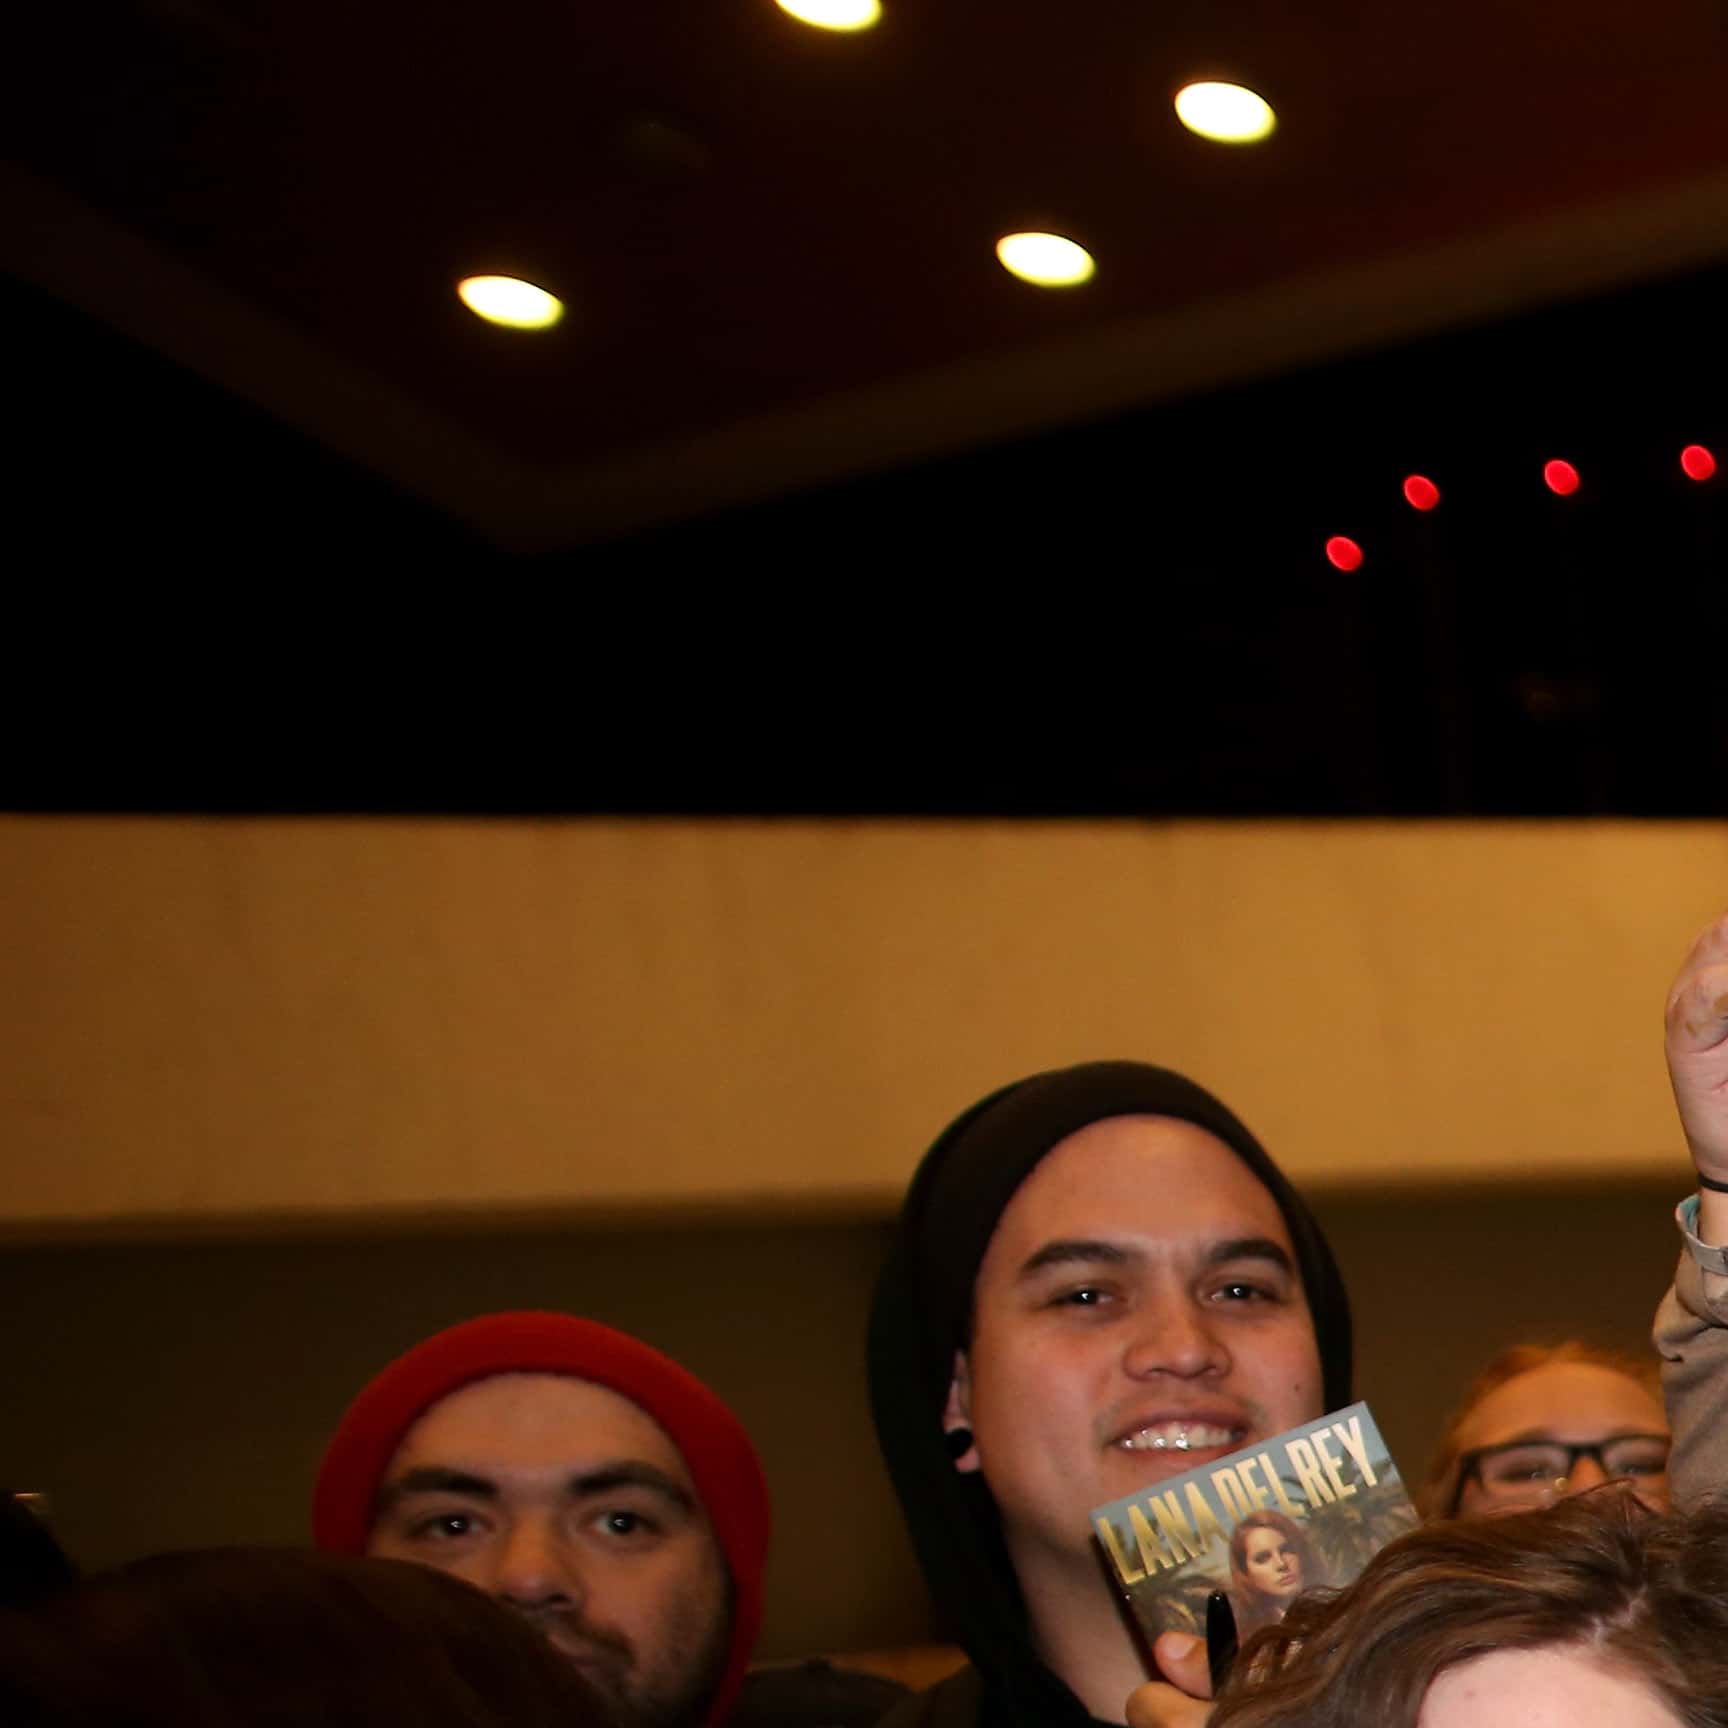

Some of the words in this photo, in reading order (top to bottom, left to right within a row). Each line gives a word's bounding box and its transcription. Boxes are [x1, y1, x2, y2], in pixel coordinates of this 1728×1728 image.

[1097, 1480, 1233, 1585] LANA
[1210, 1452, 1305, 1519] DEL
[1284, 1415, 1378, 1509] REY
